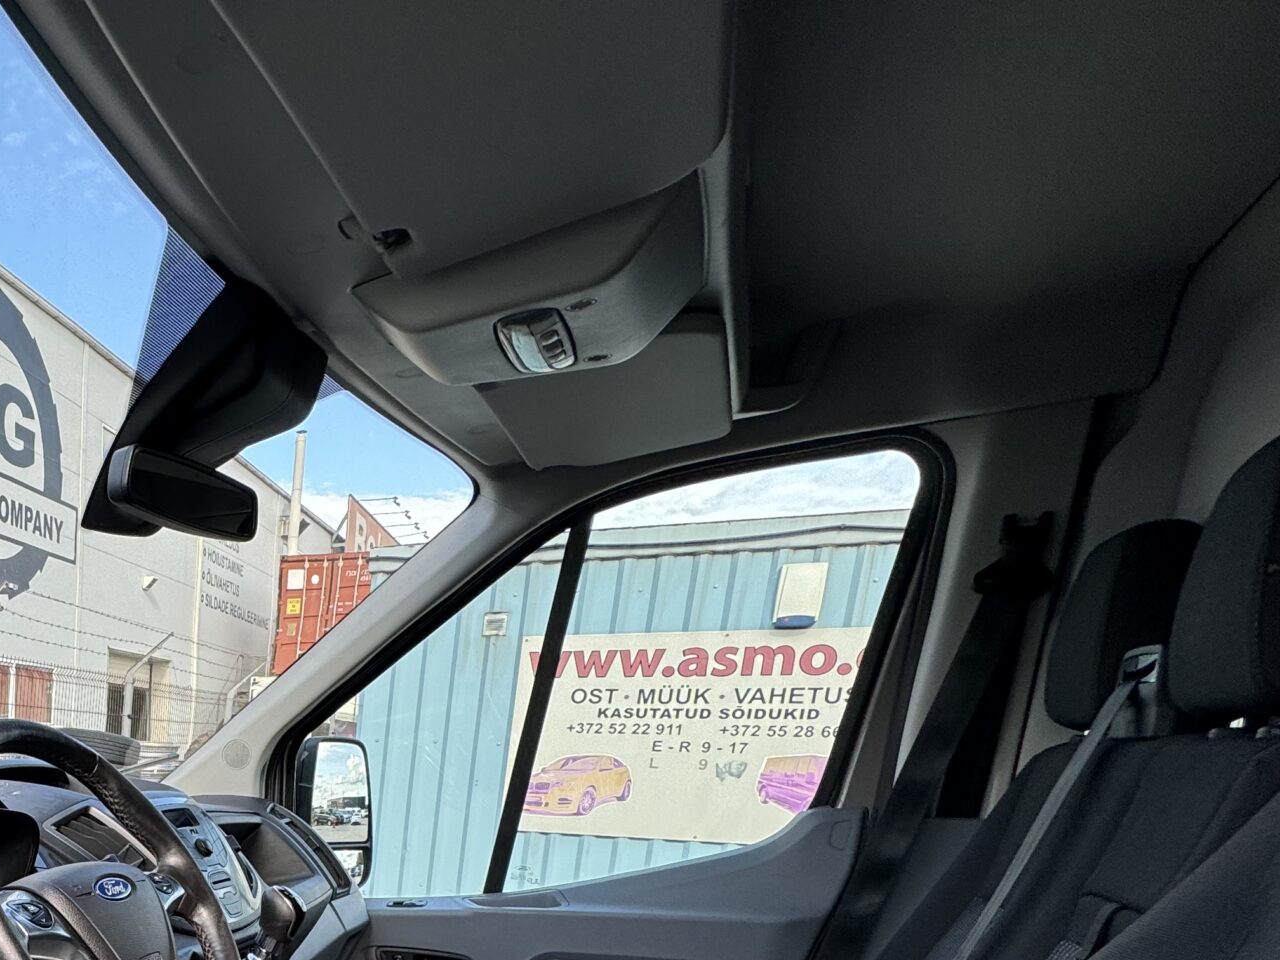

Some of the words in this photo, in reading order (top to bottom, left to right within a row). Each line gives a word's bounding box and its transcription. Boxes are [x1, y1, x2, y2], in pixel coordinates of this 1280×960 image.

[570, 688, 619, 704] OST
[637, 684, 712, 705] MÜÜK
[597, 707, 712, 719] KASUTATUD
[718, 705, 820, 720] SÕIDUKID
[567, 722, 603, 735] +372
[608, 723, 626, 735] 52
[631, 723, 650, 735] 22
[656, 723, 682, 736] 911
[720, 724, 761, 737] +372
[767, 725, 788, 738] 55
[793, 725, 814, 738] 28
[729, 742, 749, 754] 17
[103, 880, 126, 896] Ford
